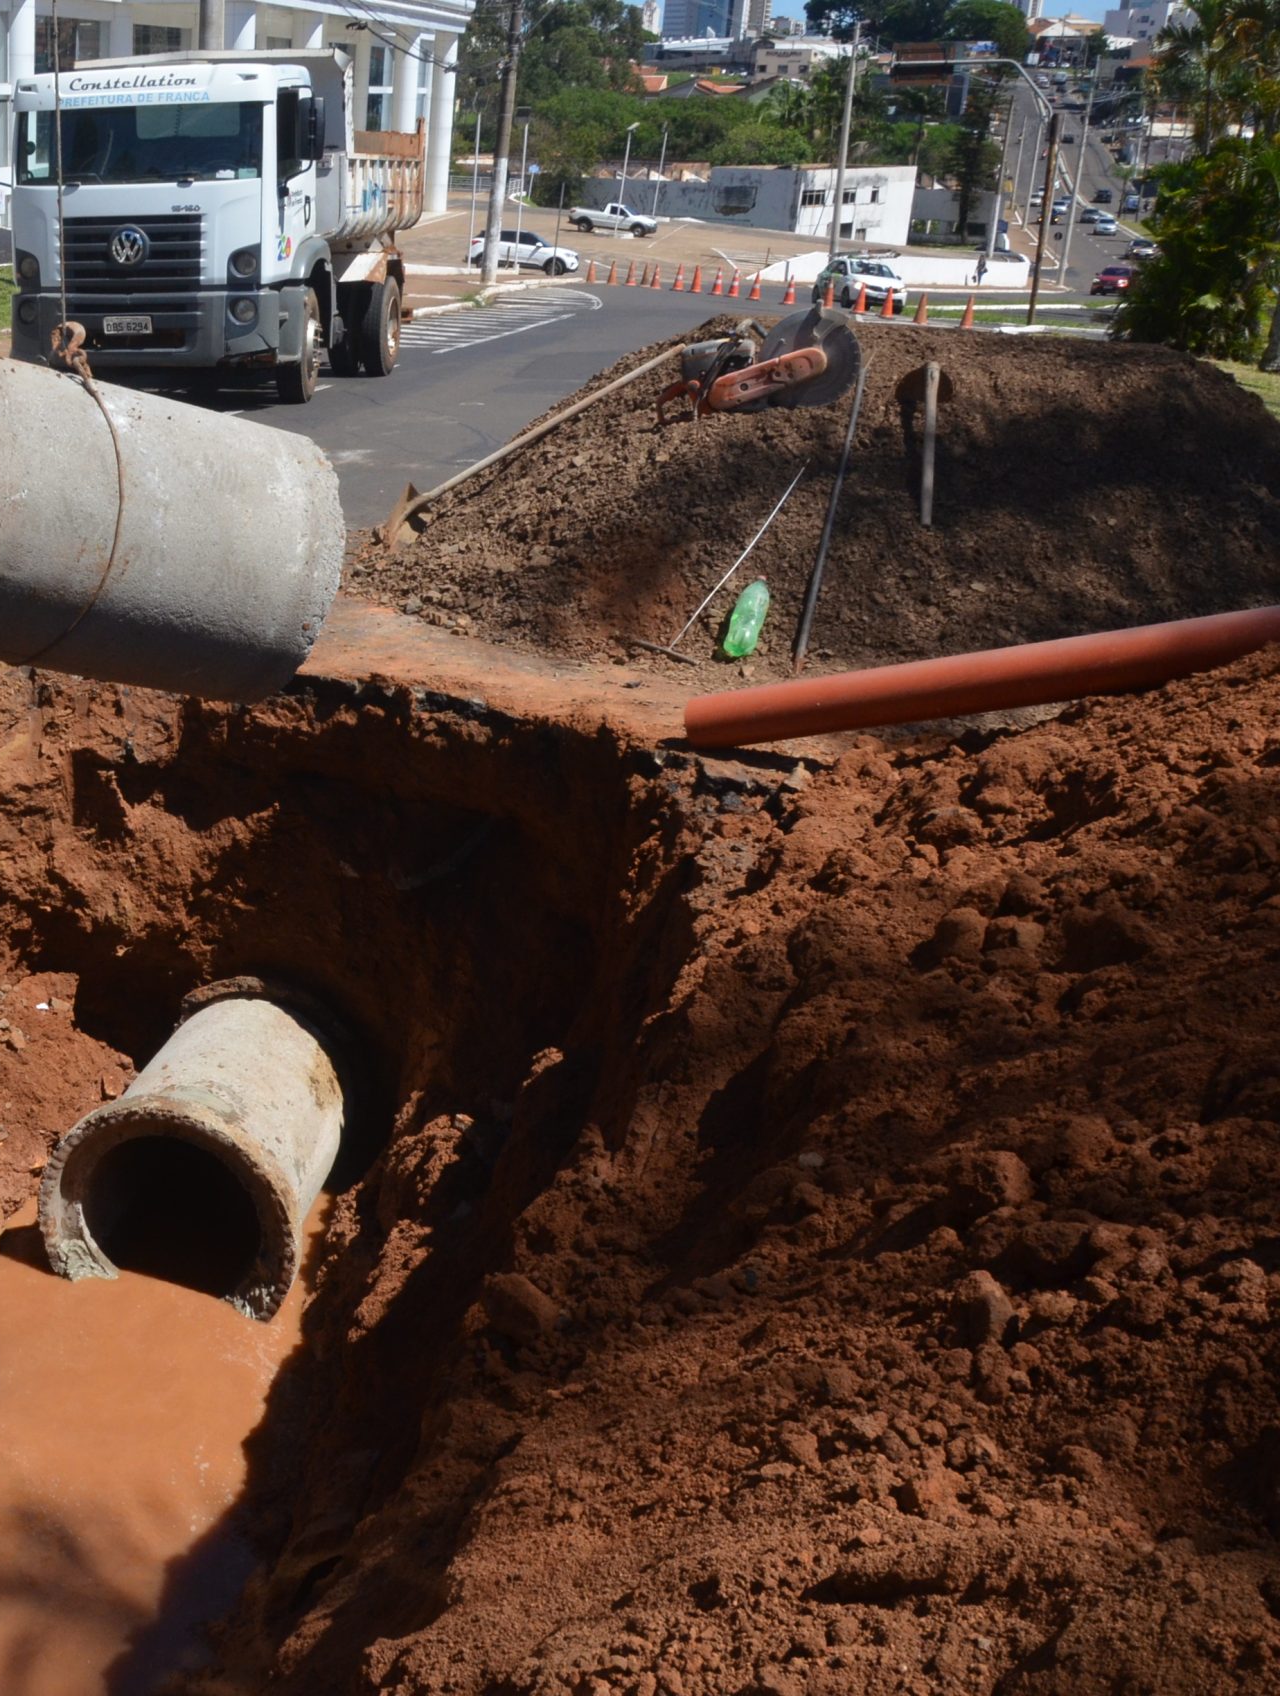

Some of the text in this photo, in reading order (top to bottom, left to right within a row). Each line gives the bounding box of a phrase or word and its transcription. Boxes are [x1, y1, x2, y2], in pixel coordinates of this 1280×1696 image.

[69, 73, 198, 91] Constellation
[59, 91, 210, 107] PREFEITURA DE FRANCA
